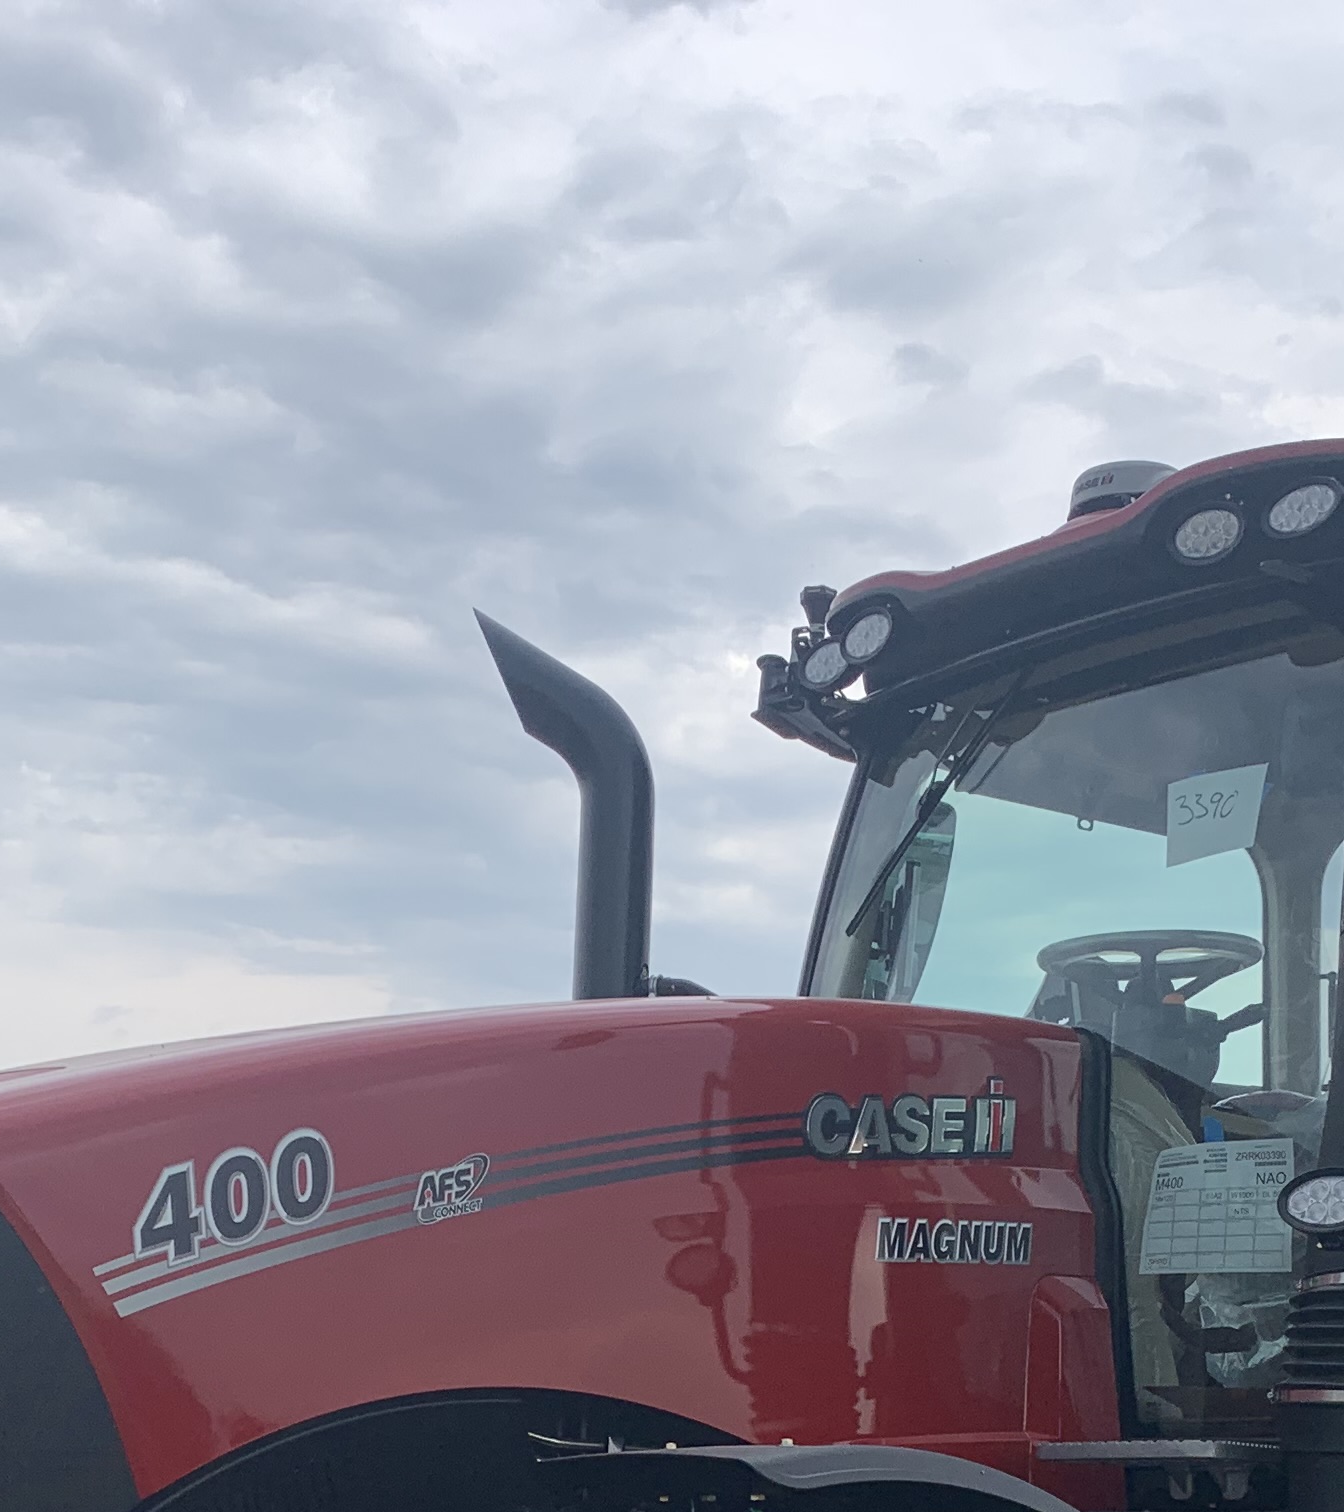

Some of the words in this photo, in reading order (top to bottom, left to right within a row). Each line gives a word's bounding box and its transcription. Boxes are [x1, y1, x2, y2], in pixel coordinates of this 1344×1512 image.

[1174, 790, 1238, 827] 3390
[805, 1091, 968, 1158] CASE
[133, 1127, 335, 1267] 400
[415, 1164, 473, 1209] AFS
[1155, 1176, 1184, 1192] M400
[433, 1199, 482, 1219] CONNECT
[875, 1216, 1033, 1266] MAGNUM
